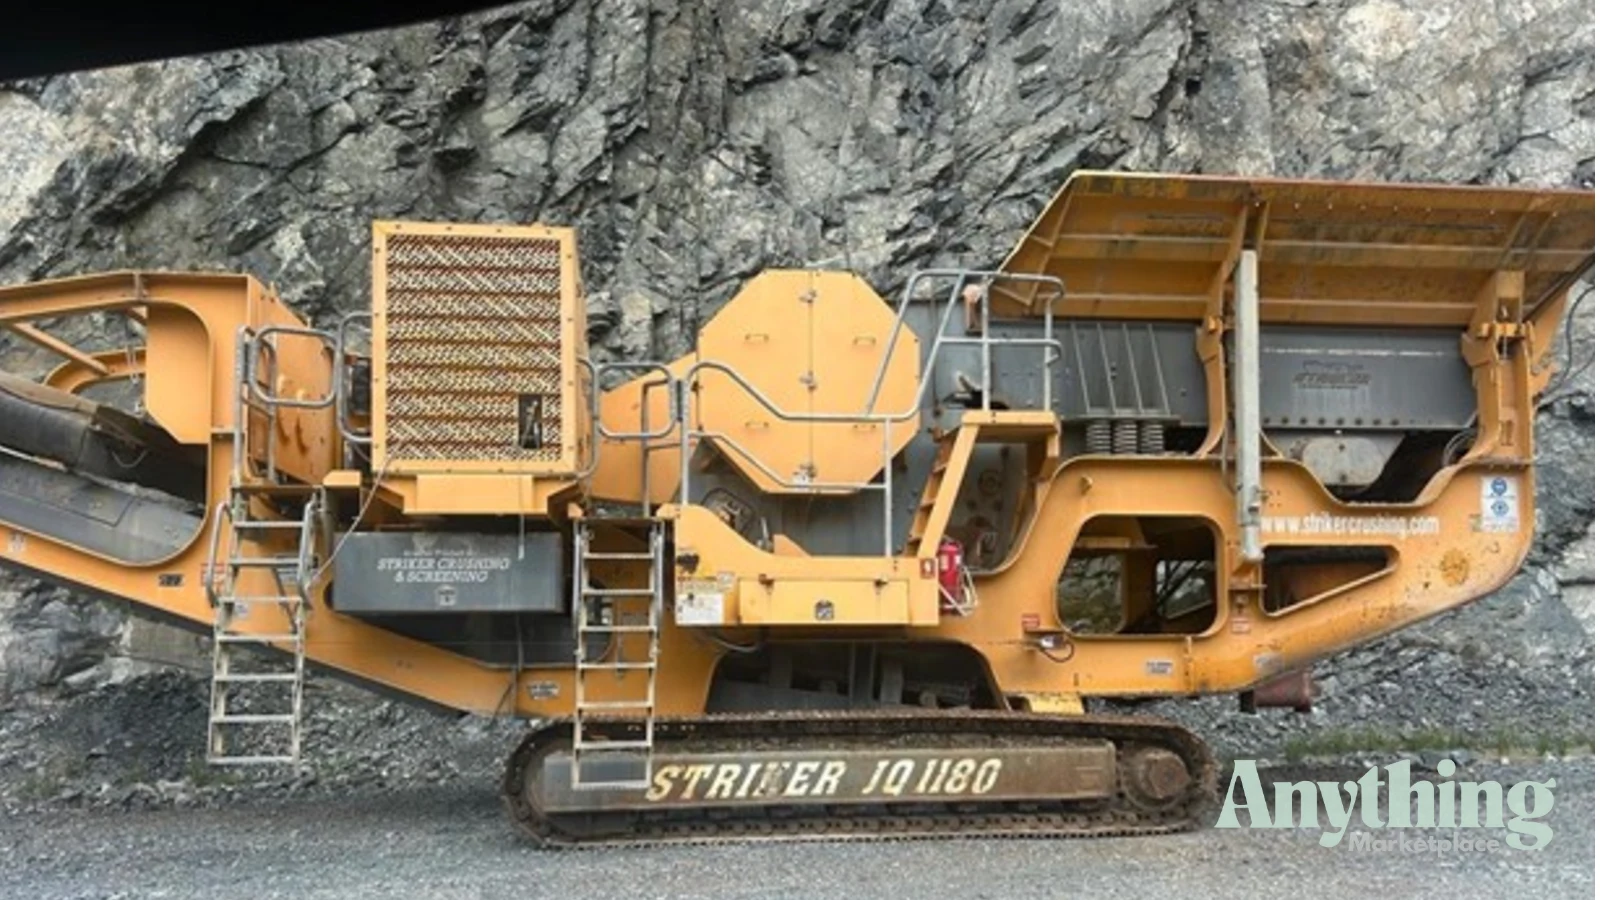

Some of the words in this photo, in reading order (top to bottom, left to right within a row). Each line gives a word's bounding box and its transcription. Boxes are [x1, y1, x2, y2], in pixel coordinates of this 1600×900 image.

[377, 557, 433, 570] STRIKER
[438, 557, 511, 570] CRUSHING
[407, 571, 488, 583] SCREENING
[915, 758, 1003, 793] 1180
